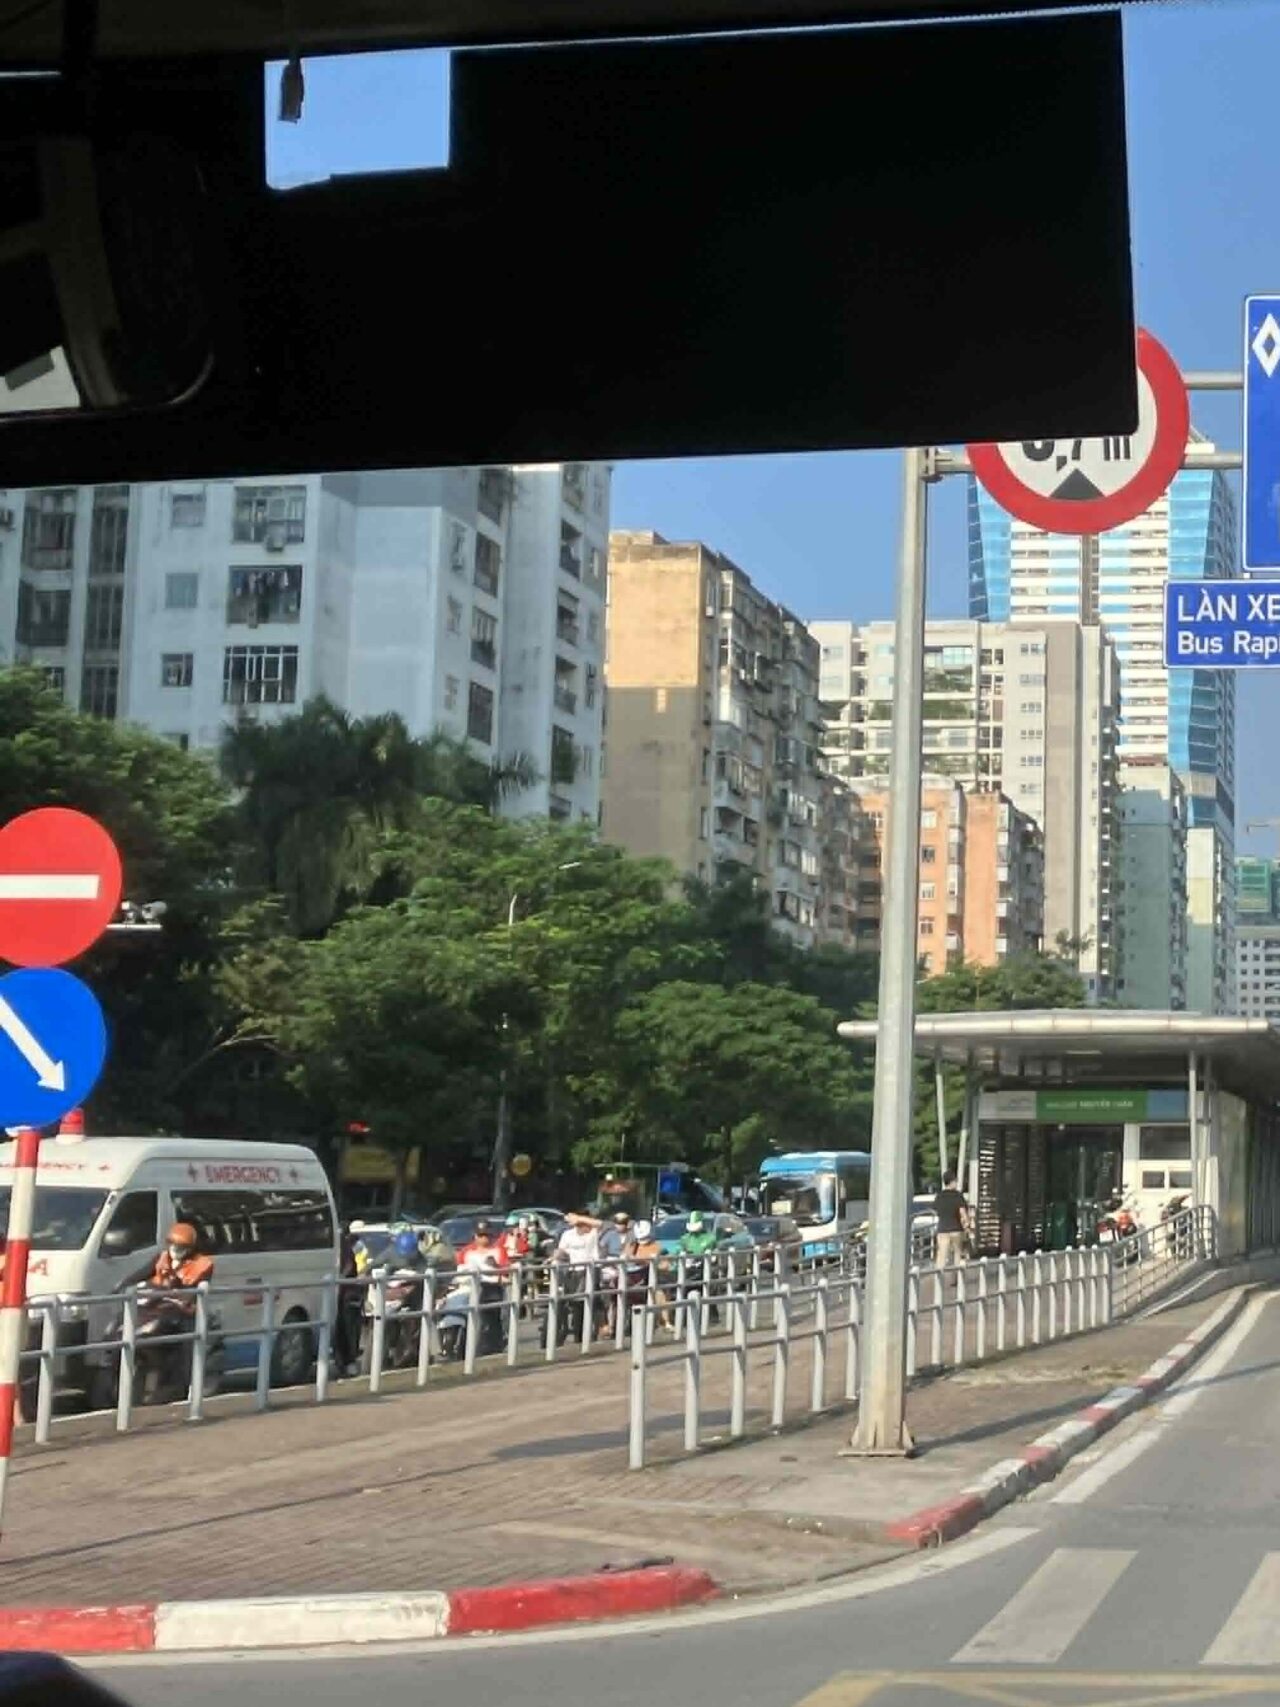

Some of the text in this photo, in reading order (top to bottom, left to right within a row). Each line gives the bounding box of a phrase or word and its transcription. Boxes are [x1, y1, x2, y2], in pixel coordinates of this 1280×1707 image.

[1177, 588, 1237, 622] LÀN
[1177, 631, 1223, 655] Bus
[204, 1164, 282, 1184] EMERGENCY
